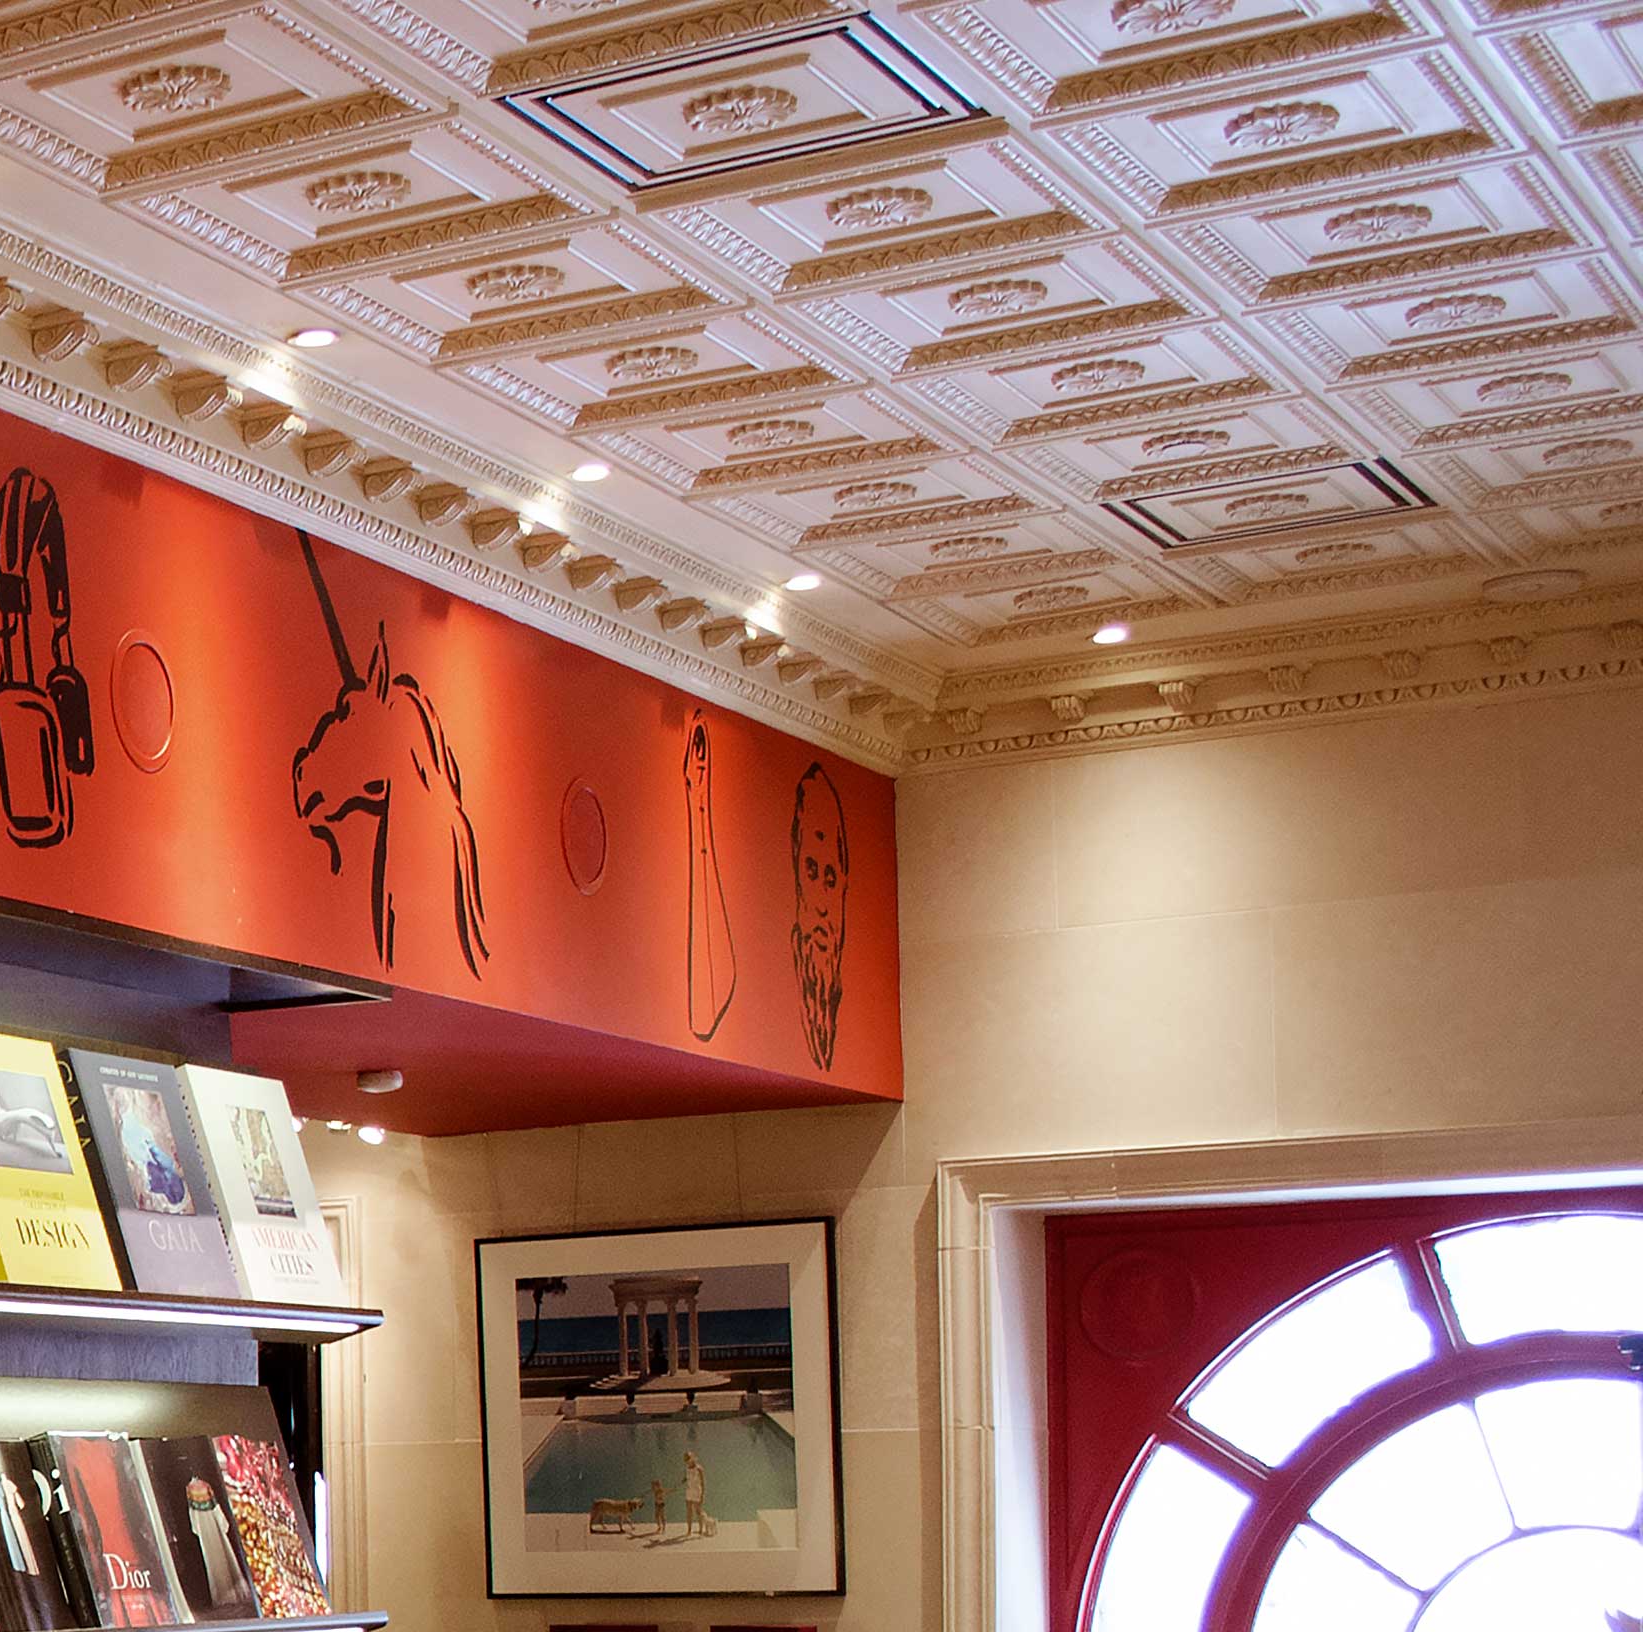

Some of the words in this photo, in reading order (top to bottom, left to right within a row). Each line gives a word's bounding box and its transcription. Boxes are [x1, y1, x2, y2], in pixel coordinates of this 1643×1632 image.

[57, 1061, 93, 1151] GAIA
[14, 1216, 92, 1249] DESIGN
[148, 1219, 204, 1254] GAIA
[251, 1227, 320, 1251] AMERICAN
[268, 1253, 315, 1276] CITIES
[102, 1552, 151, 1591] Dior
